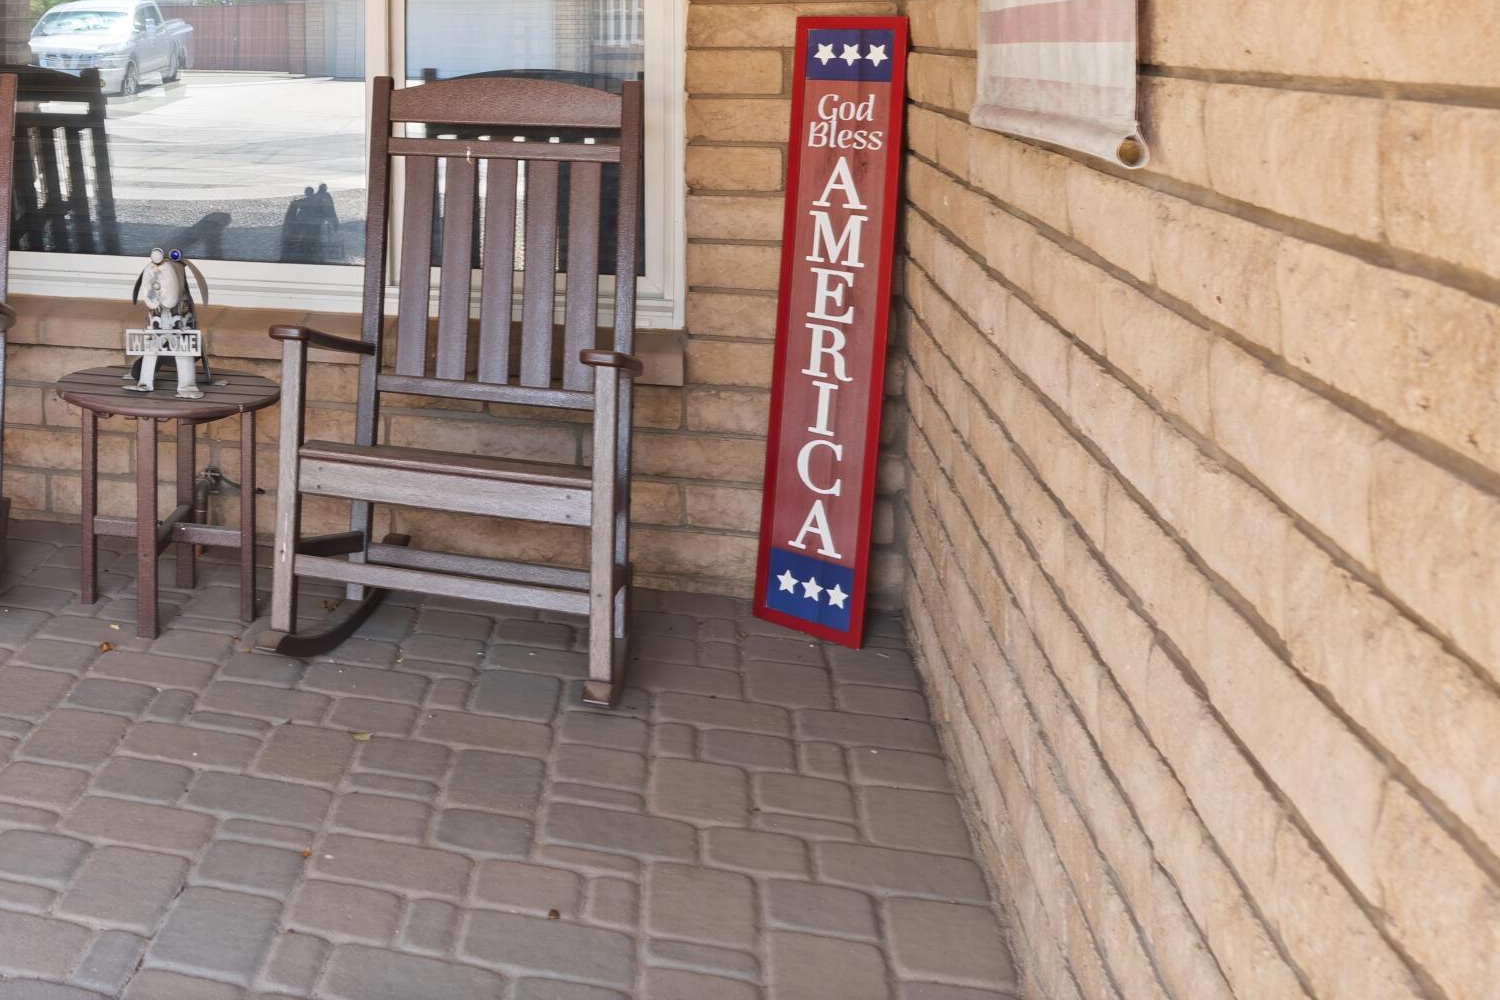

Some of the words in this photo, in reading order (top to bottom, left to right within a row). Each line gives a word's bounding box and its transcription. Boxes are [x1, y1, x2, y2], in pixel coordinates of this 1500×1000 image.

[818, 93, 875, 121] God
[808, 120, 884, 150] Bless
[788, 155, 869, 560] AMERICA
